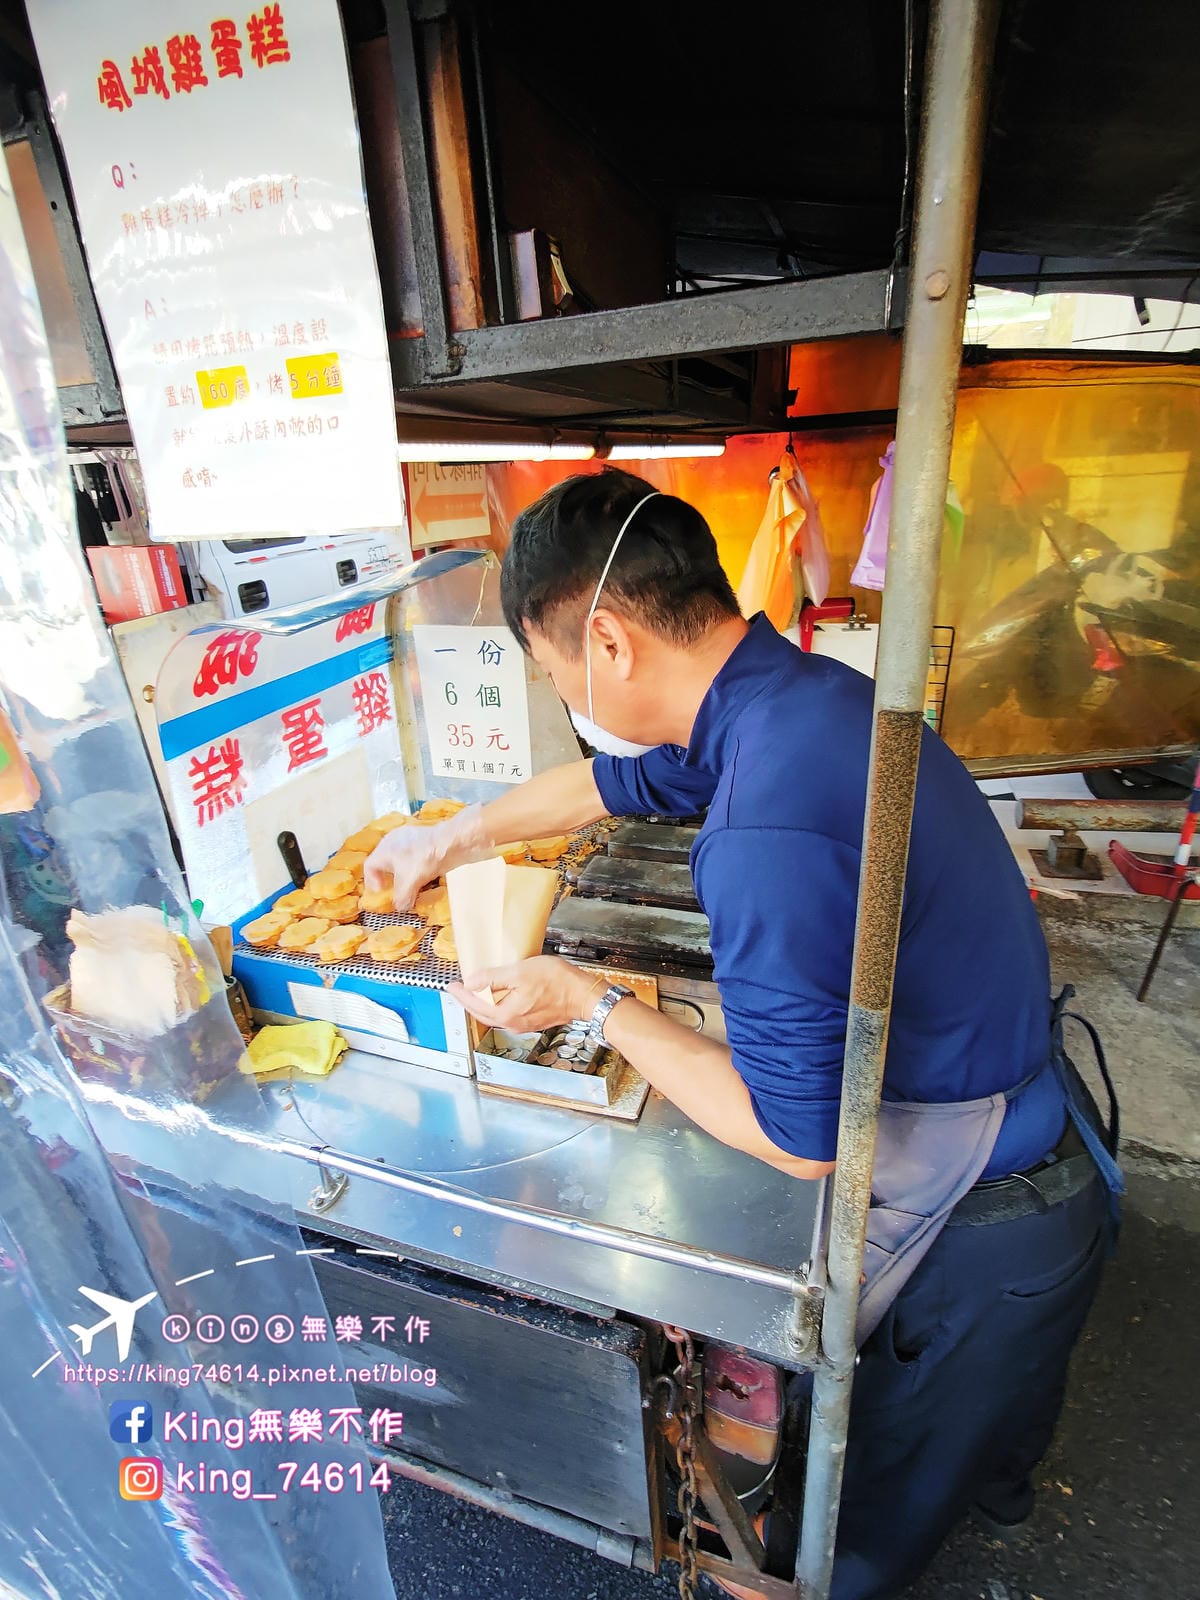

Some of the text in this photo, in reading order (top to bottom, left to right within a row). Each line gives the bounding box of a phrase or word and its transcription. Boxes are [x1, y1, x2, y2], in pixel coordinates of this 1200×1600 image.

[98, 3, 290, 112] 風城雞蛋糕
[434, 639, 506, 666] 一份
[444, 682, 501, 708] 6個
[447, 723, 510, 751] 35元
